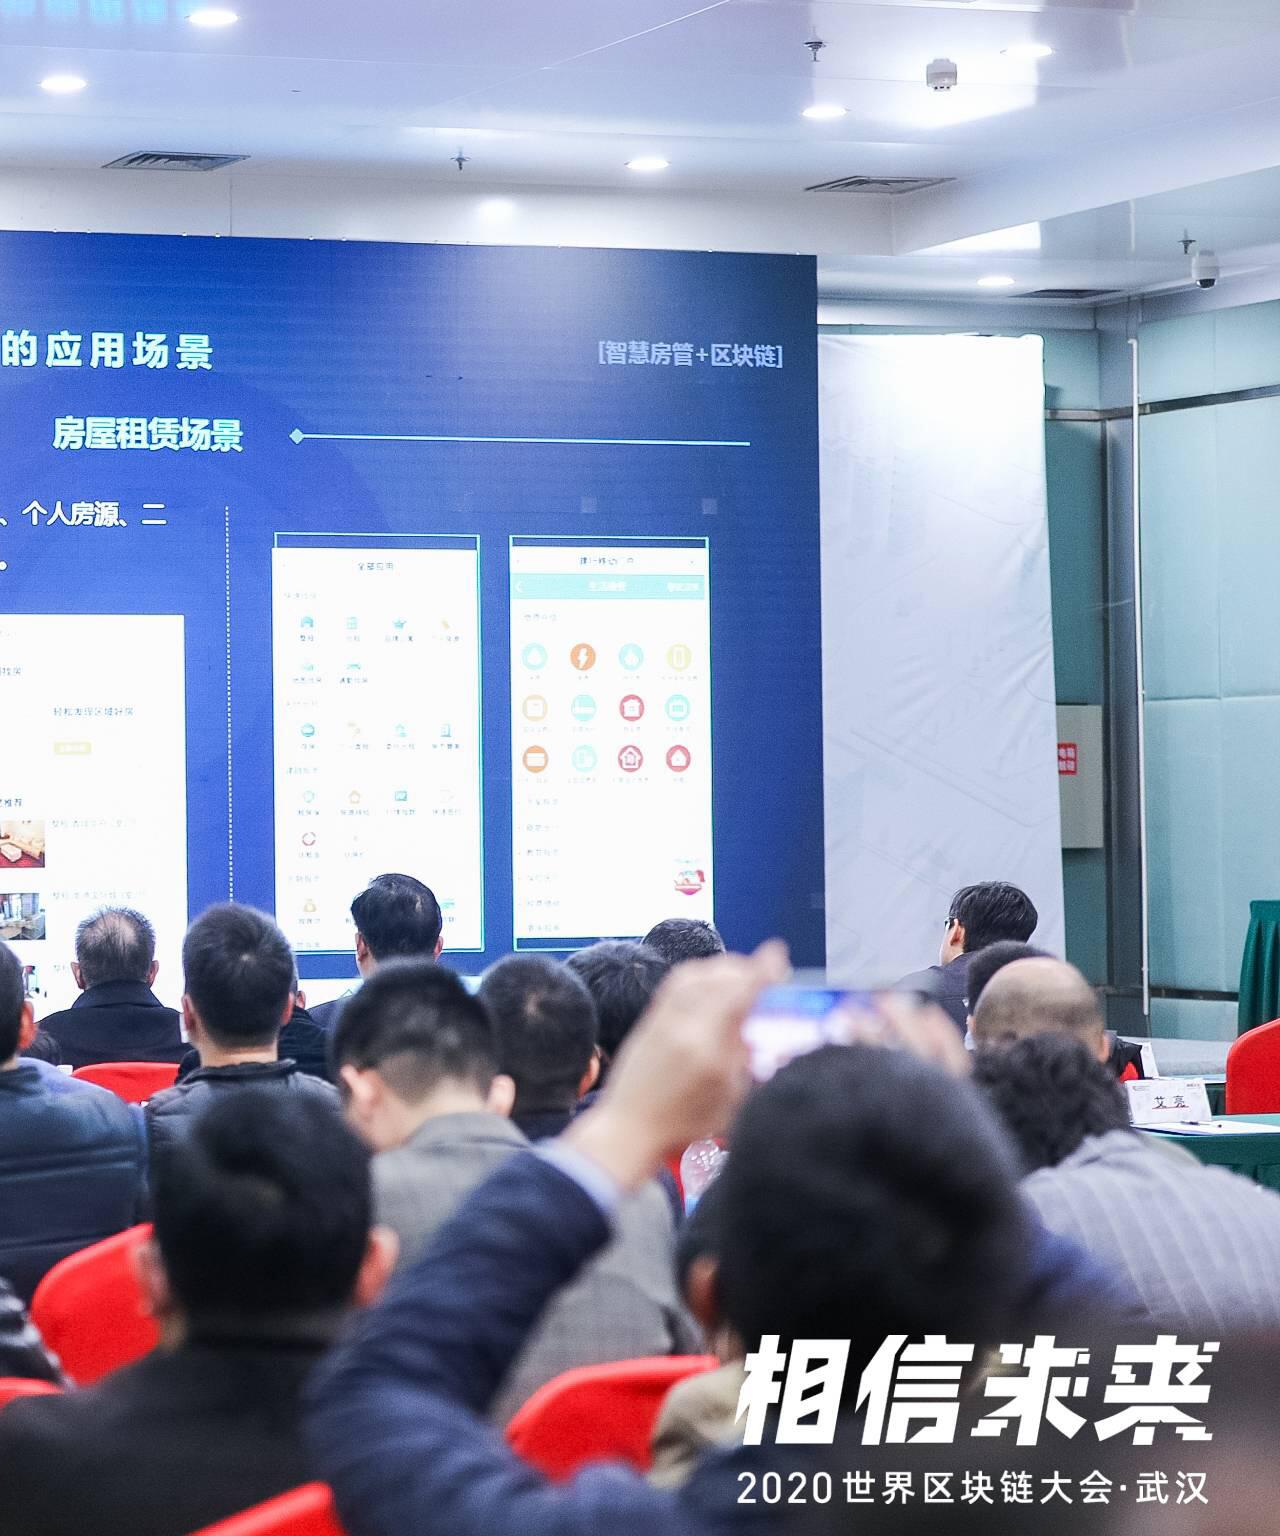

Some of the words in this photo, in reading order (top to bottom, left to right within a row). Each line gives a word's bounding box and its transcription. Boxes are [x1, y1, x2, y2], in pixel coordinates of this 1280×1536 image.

[53, 415, 244, 452] 房屋租赁场景
